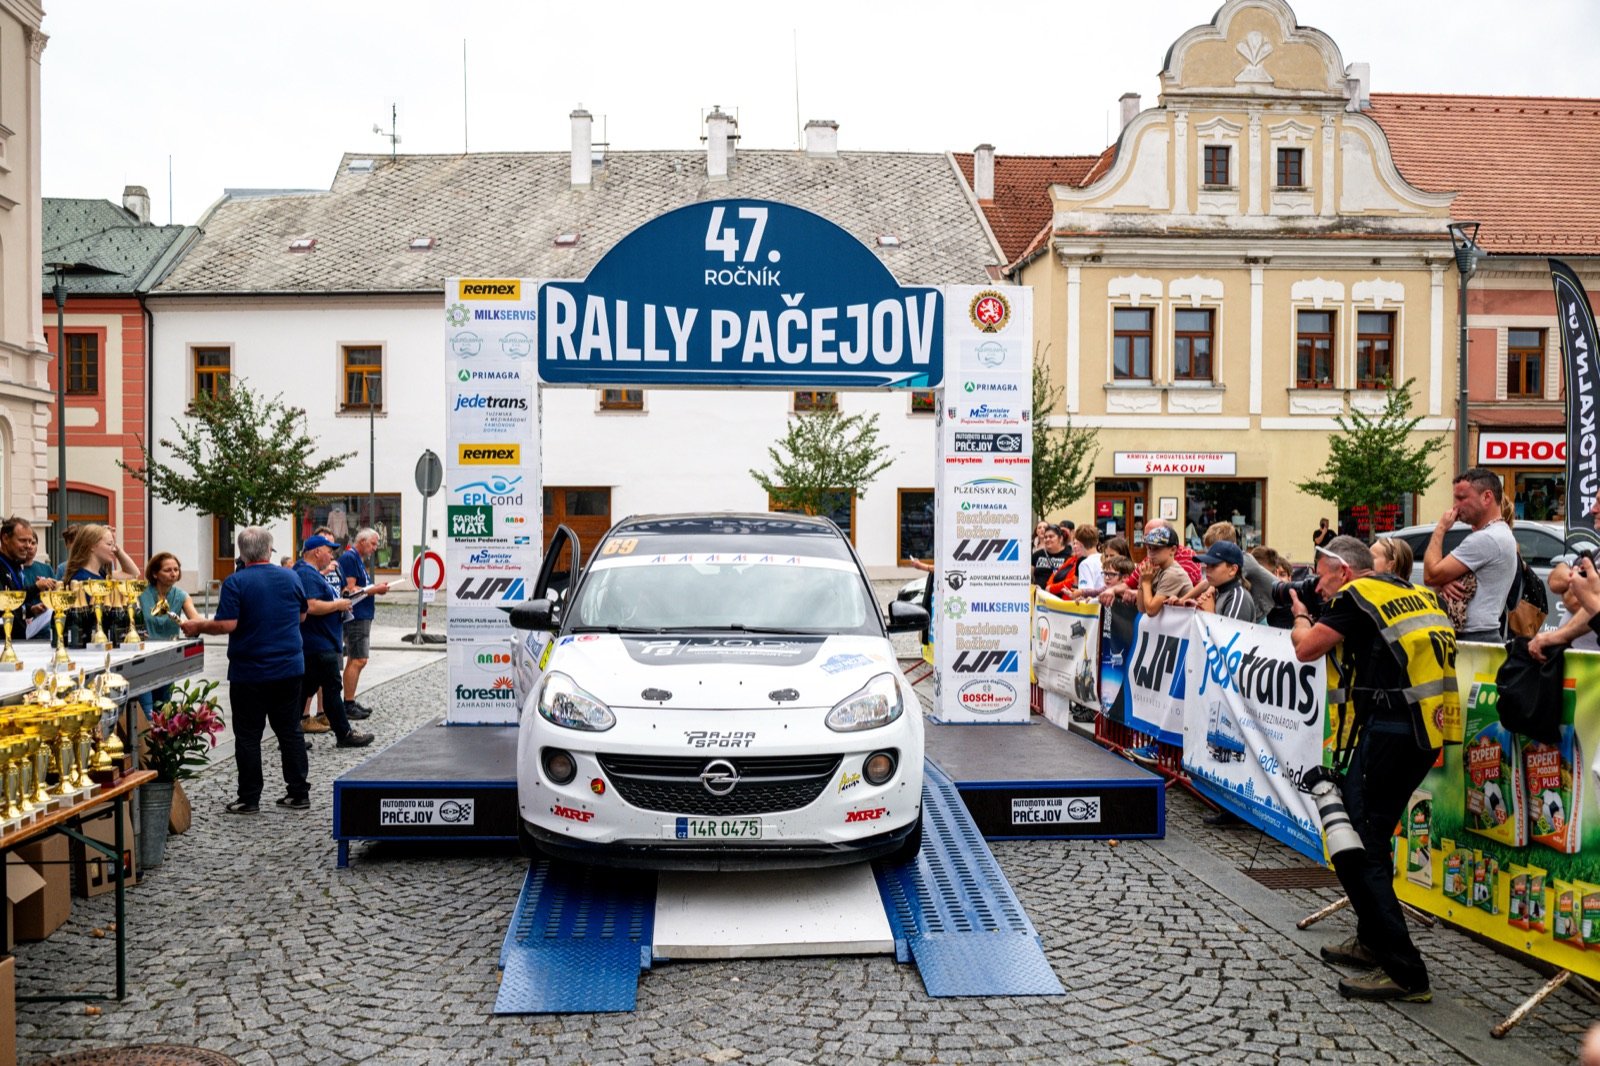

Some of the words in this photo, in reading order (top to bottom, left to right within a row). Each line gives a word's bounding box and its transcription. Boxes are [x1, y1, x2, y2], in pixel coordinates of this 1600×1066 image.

[705, 206, 780, 263] 47.
[704, 266, 781, 287] ROČNÍK
[474, 309, 536, 321] MILKSERVIS
[546, 286, 698, 363] RALLY
[711, 291, 937, 365] PAČEJOV
[472, 372, 520, 380] PRIMAGRA
[955, 440, 992, 451] PAČEJOV
[1145, 461, 1205, 472] ŠMAKOUN
[954, 485, 996, 494] PLZEŇSKÝ
[997, 487, 1017, 496] KRAJ
[956, 511, 1019, 525] Rezidence
[602, 538, 639, 555] 69
[971, 602, 1030, 613] MILKSERVIS
[1380, 596, 1428, 620] MEDIA
[956, 623, 1019, 636] Rezidence
[956, 636, 1001, 650] Božkov
[455, 684, 516, 700] forestin
[962, 693, 994, 702] BOSCH
[695, 740, 753, 748] SPORT
[1471, 745, 1500, 763] EXPERT
[1527, 750, 1559, 768] EXPERT
[1485, 767, 1499, 779] PLUS
[1542, 777, 1560, 787] PLUS
[382, 800, 417, 808] AUTOMOTO
[417, 800, 434, 808] KLUB
[1013, 799, 1045, 808] AUTOMOTO
[1047, 799, 1062, 807] KLUB
[382, 808, 433, 823] PAČEJOV
[553, 805, 595, 823] MRF
[845, 808, 886, 823] MRF
[1013, 807, 1062, 823] PAČEJOV
[690, 820, 717, 836] 14R
[721, 820, 758, 836] 0475
